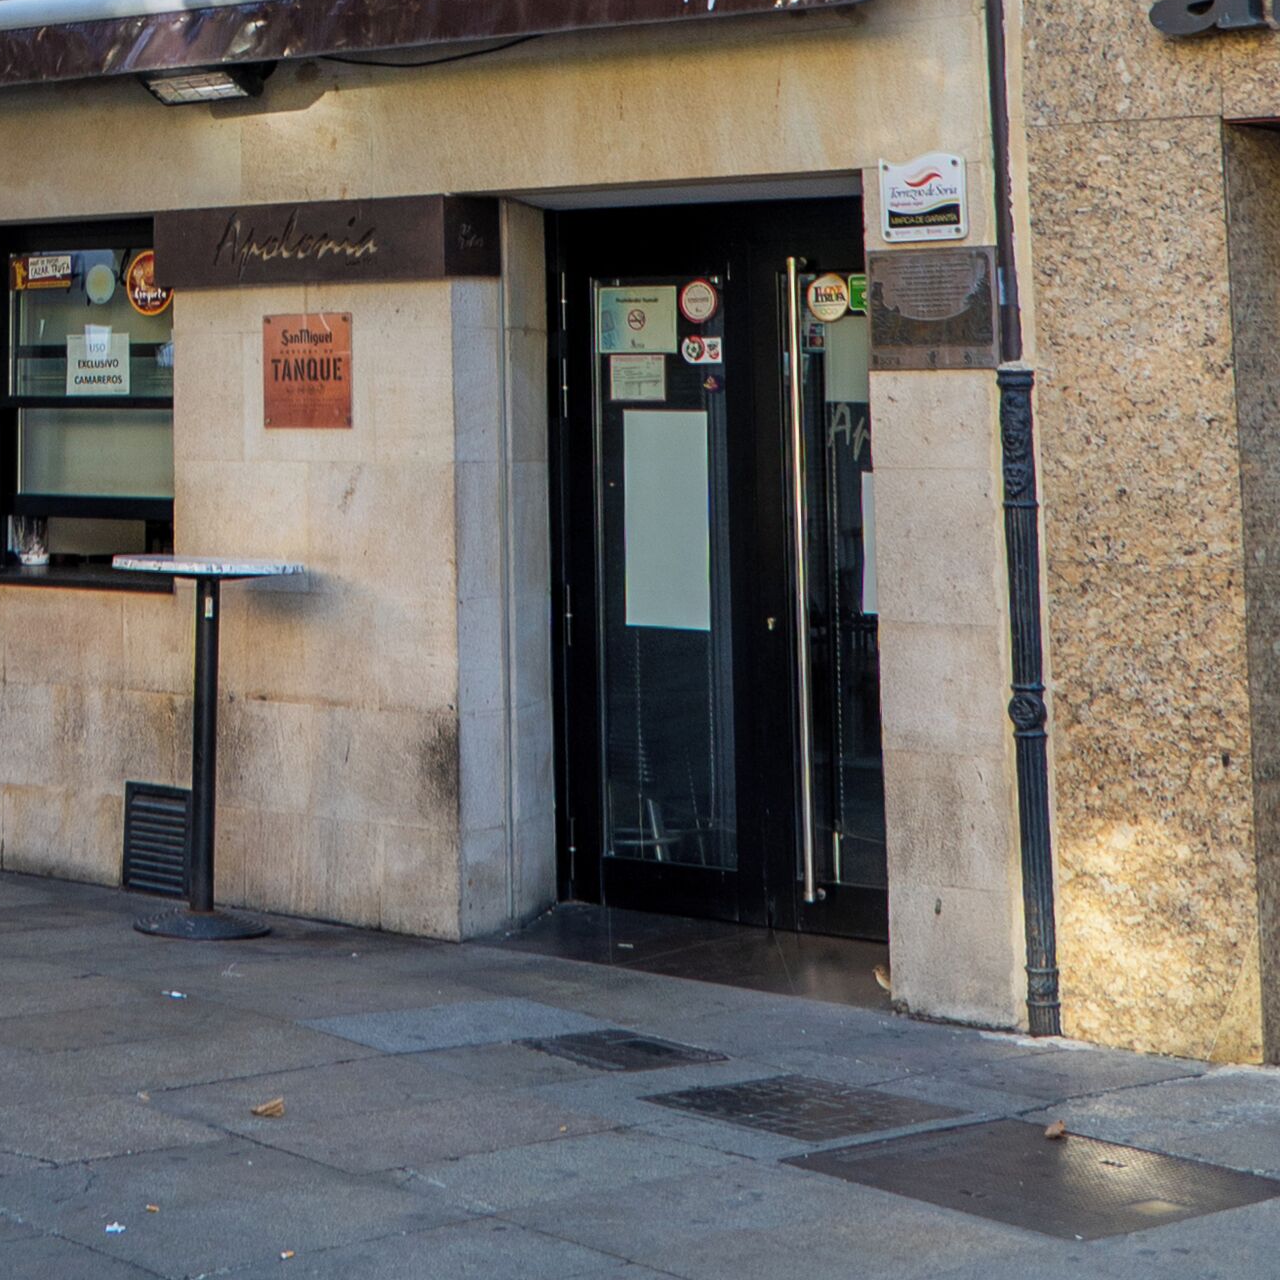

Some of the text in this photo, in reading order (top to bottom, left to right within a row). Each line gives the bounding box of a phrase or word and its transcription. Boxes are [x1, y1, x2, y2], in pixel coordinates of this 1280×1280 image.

[213, 207, 378, 281] Apolonia
[89, 343, 106, 353] USO
[77, 359, 119, 369] EXCLUSIVO
[271, 357, 343, 382] TANQUE
[74, 375, 122, 385] CAMAREROS
